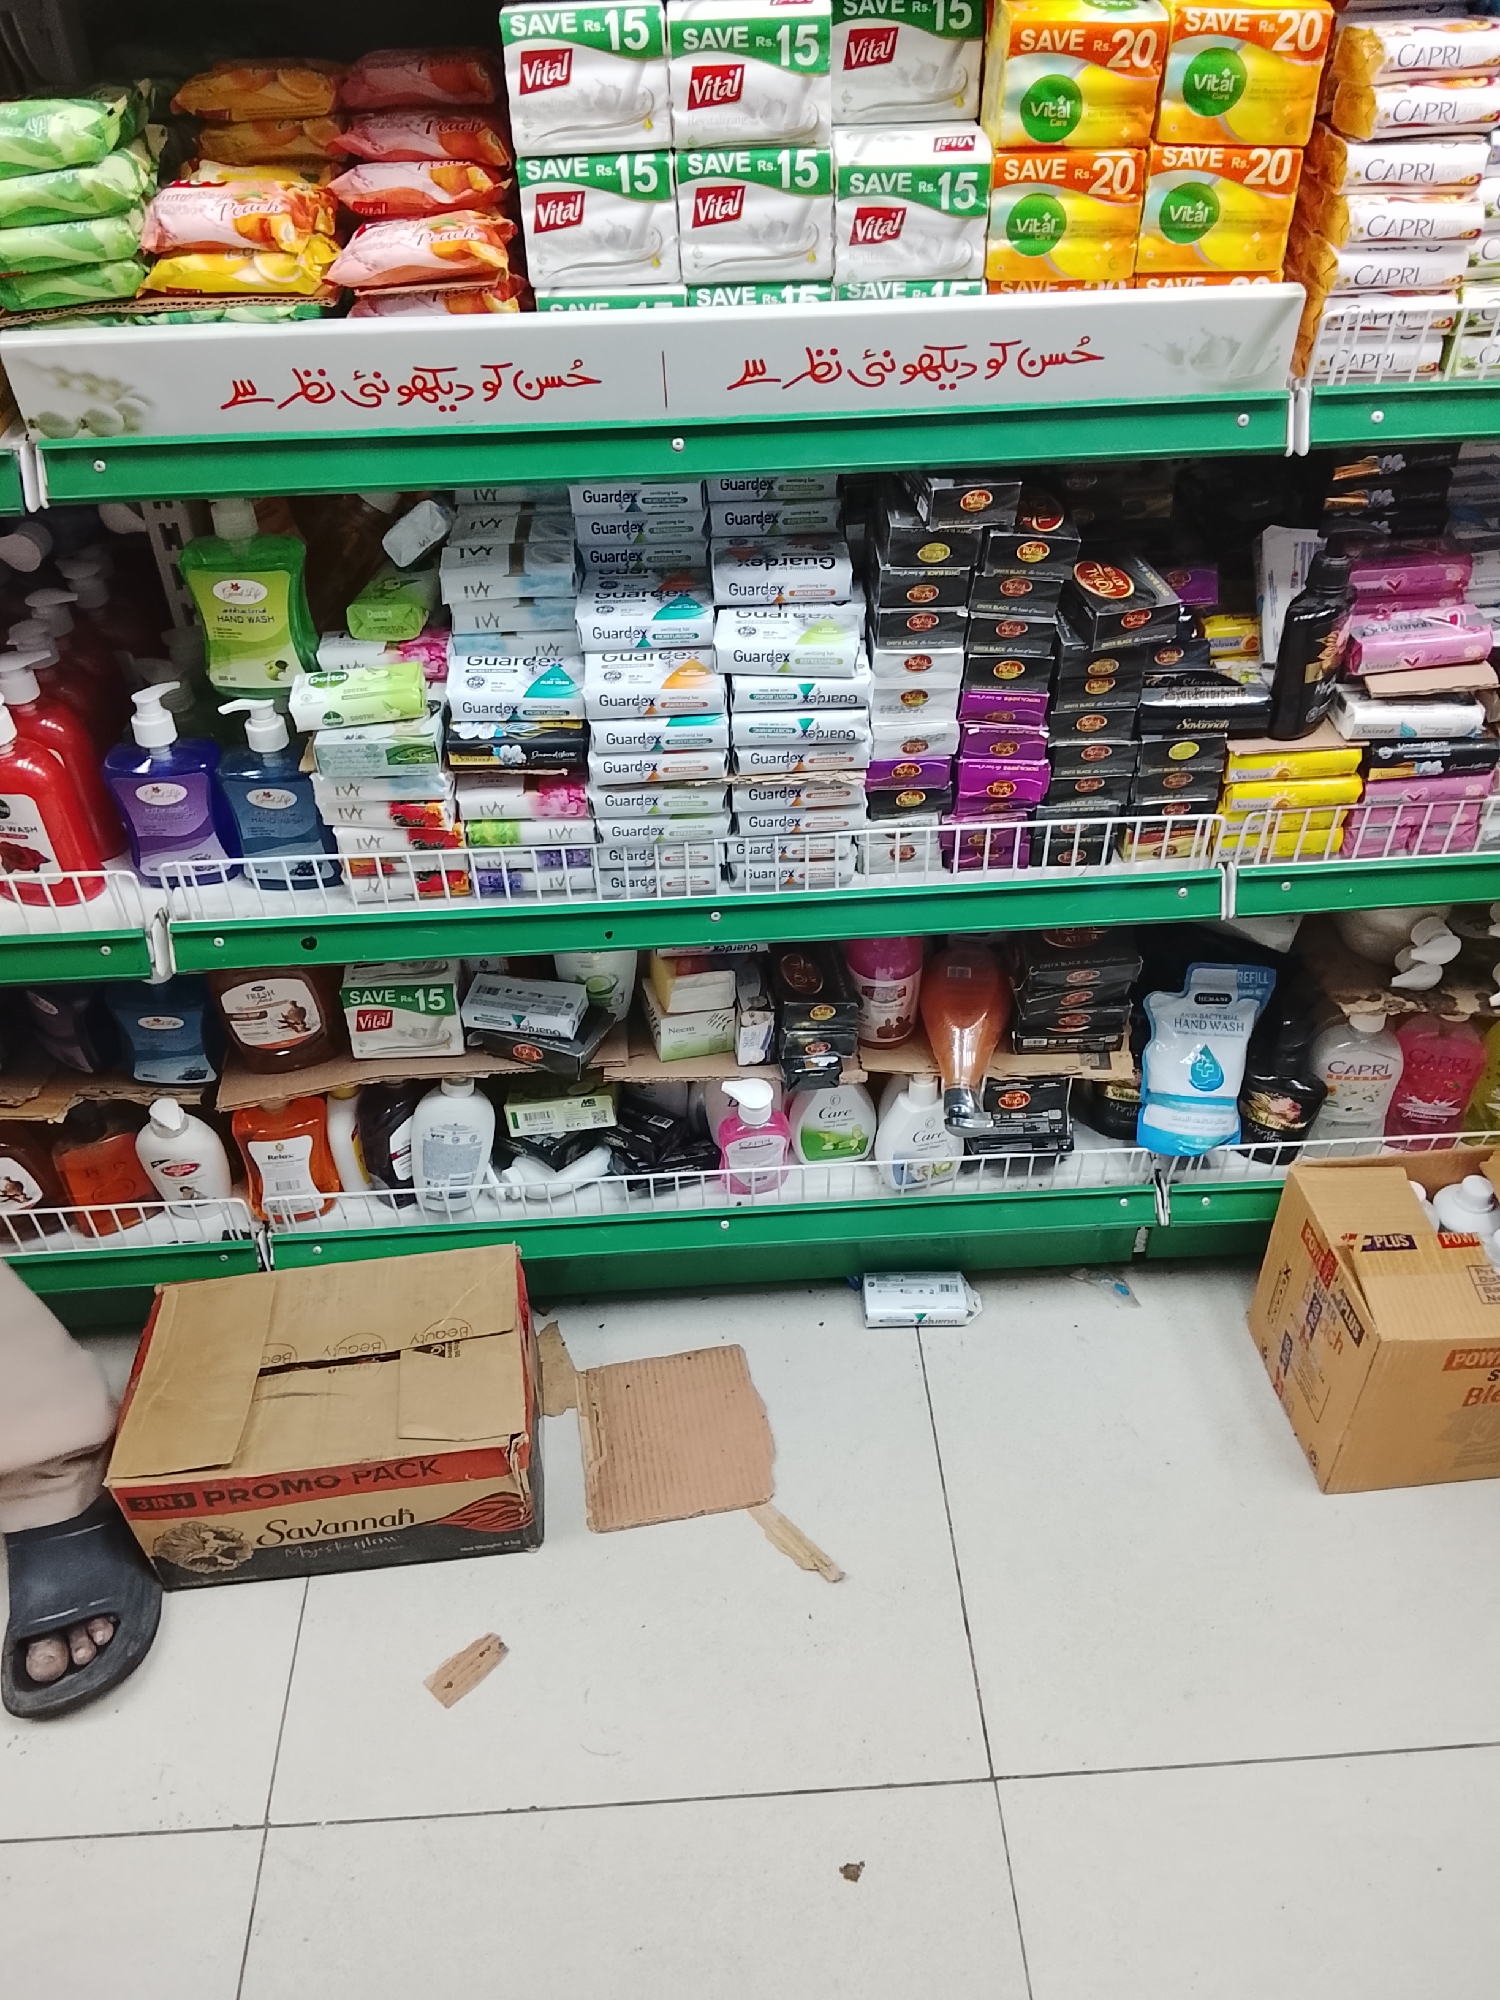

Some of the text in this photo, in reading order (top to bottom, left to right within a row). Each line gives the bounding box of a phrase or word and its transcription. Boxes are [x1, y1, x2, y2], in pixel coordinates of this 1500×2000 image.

[843, 0, 973, 31] SAVE Rs. 15
[510, 9, 649, 51] SAVE Rs. 15
[1185, 10, 1323, 51] SAVE Rs. 20
[683, 24, 819, 67] SAVE Rs. 15
[848, 31, 895, 66] Vital
[1020, 29, 1157, 68] SAVE Rs. 20
[1397, 44, 1464, 68] CAPRI
[521, 54, 569, 88] Vital
[691, 70, 742, 104] Vital
[1193, 70, 1236, 93] Vital
[1030, 98, 1072, 119] Vital
[1393, 99, 1459, 124] CAPRI
[936, 137, 974, 151] Vital
[525, 153, 658, 194] SAVE Rs. 15
[688, 149, 819, 189] SAVE Rs. 15
[1161, 148, 1293, 186] SAVE Rs. 20
[1365, 159, 1438, 185] CAPRI
[1003, 158, 1136, 195] SAVE Rs. 20
[850, 171, 978, 210] SAVE Rs. 15
[214, 198, 285, 222] Peach
[536, 196, 582, 228] Vital
[697, 190, 742, 223] Vital
[1169, 203, 1209, 223] Vital
[855, 211, 903, 242] Vital
[1016, 214, 1058, 234] Vital
[1367, 215, 1438, 240] CAPRI
[415, 227, 481, 247] Peach
[1354, 265, 1423, 287] CAPRI
[696, 287, 756, 306] SAVE
[847, 282, 907, 299] SAVE
[726, 335, 1105, 391] حُسن کو دیکھو نئی نظر سے
[220, 359, 603, 412] حُسن کو دیکھو نئی نظر سے
[720, 477, 774, 491] Guardex
[474, 489, 497, 501] IVY
[583, 490, 638, 503] Guardex
[470, 518, 502, 529] IVY
[725, 511, 779, 525] Guardex
[591, 520, 645, 535] Guardex
[460, 545, 494, 559] IVY
[590, 549, 643, 563] Guardex
[737, 556, 836, 571] Guardex
[1086, 568, 1117, 594] ROYAL
[1103, 566, 1129, 590] LATHER
[463, 581, 490, 598] IVY
[729, 582, 785, 596] Guardex
[216, 615, 275, 624] HAND WASH
[474, 612, 500, 629] IVY
[592, 626, 647, 640] Guardex
[1362, 621, 1433, 637] Savannah
[535, 643, 560, 656] IVY
[733, 649, 790, 663] Guardex
[467, 656, 564, 668] Guardex
[310, 674, 347, 685] Dettol
[599, 694, 655, 707] Guardex
[801, 694, 858, 705] Guardex
[463, 702, 519, 714] Guardex
[1176, 719, 1230, 730] Savannah
[606, 733, 662, 745] Guardex
[801, 729, 856, 740] Guardex
[750, 751, 805, 765] Guardex
[603, 760, 658, 774] Guardex
[335, 783, 361, 797] IVY
[748, 788, 802, 801] Guardex
[480, 800, 505, 816] IVY
[605, 795, 659, 807] Guardex
[338, 805, 364, 820] IVY
[749, 816, 801, 829] Guardex
[548, 825, 573, 841] IVY
[612, 826, 664, 838] Guardex
[356, 834, 381, 849] IVY
[1237, 971, 1269, 984] REFILL
[350, 988, 447, 1012] SAVE 15
[358, 1012, 391, 1030] Vital
[1174, 1018, 1245, 1032] HAND WASH
[668, 1026, 695, 1035] Neem
[1327, 1060, 1394, 1077] CAPRI
[1408, 1049, 1472, 1072] CAPRI
[818, 1106, 852, 1120] Care
[912, 1129, 945, 1143] Care
[1373, 1235, 1411, 1248] PLUS
[410, 1326, 469, 1345] Beauty
[324, 1341, 382, 1356] Beauty
[203, 1458, 443, 1507] PROMO PACK
[256, 1507, 416, 1547] Savannah
